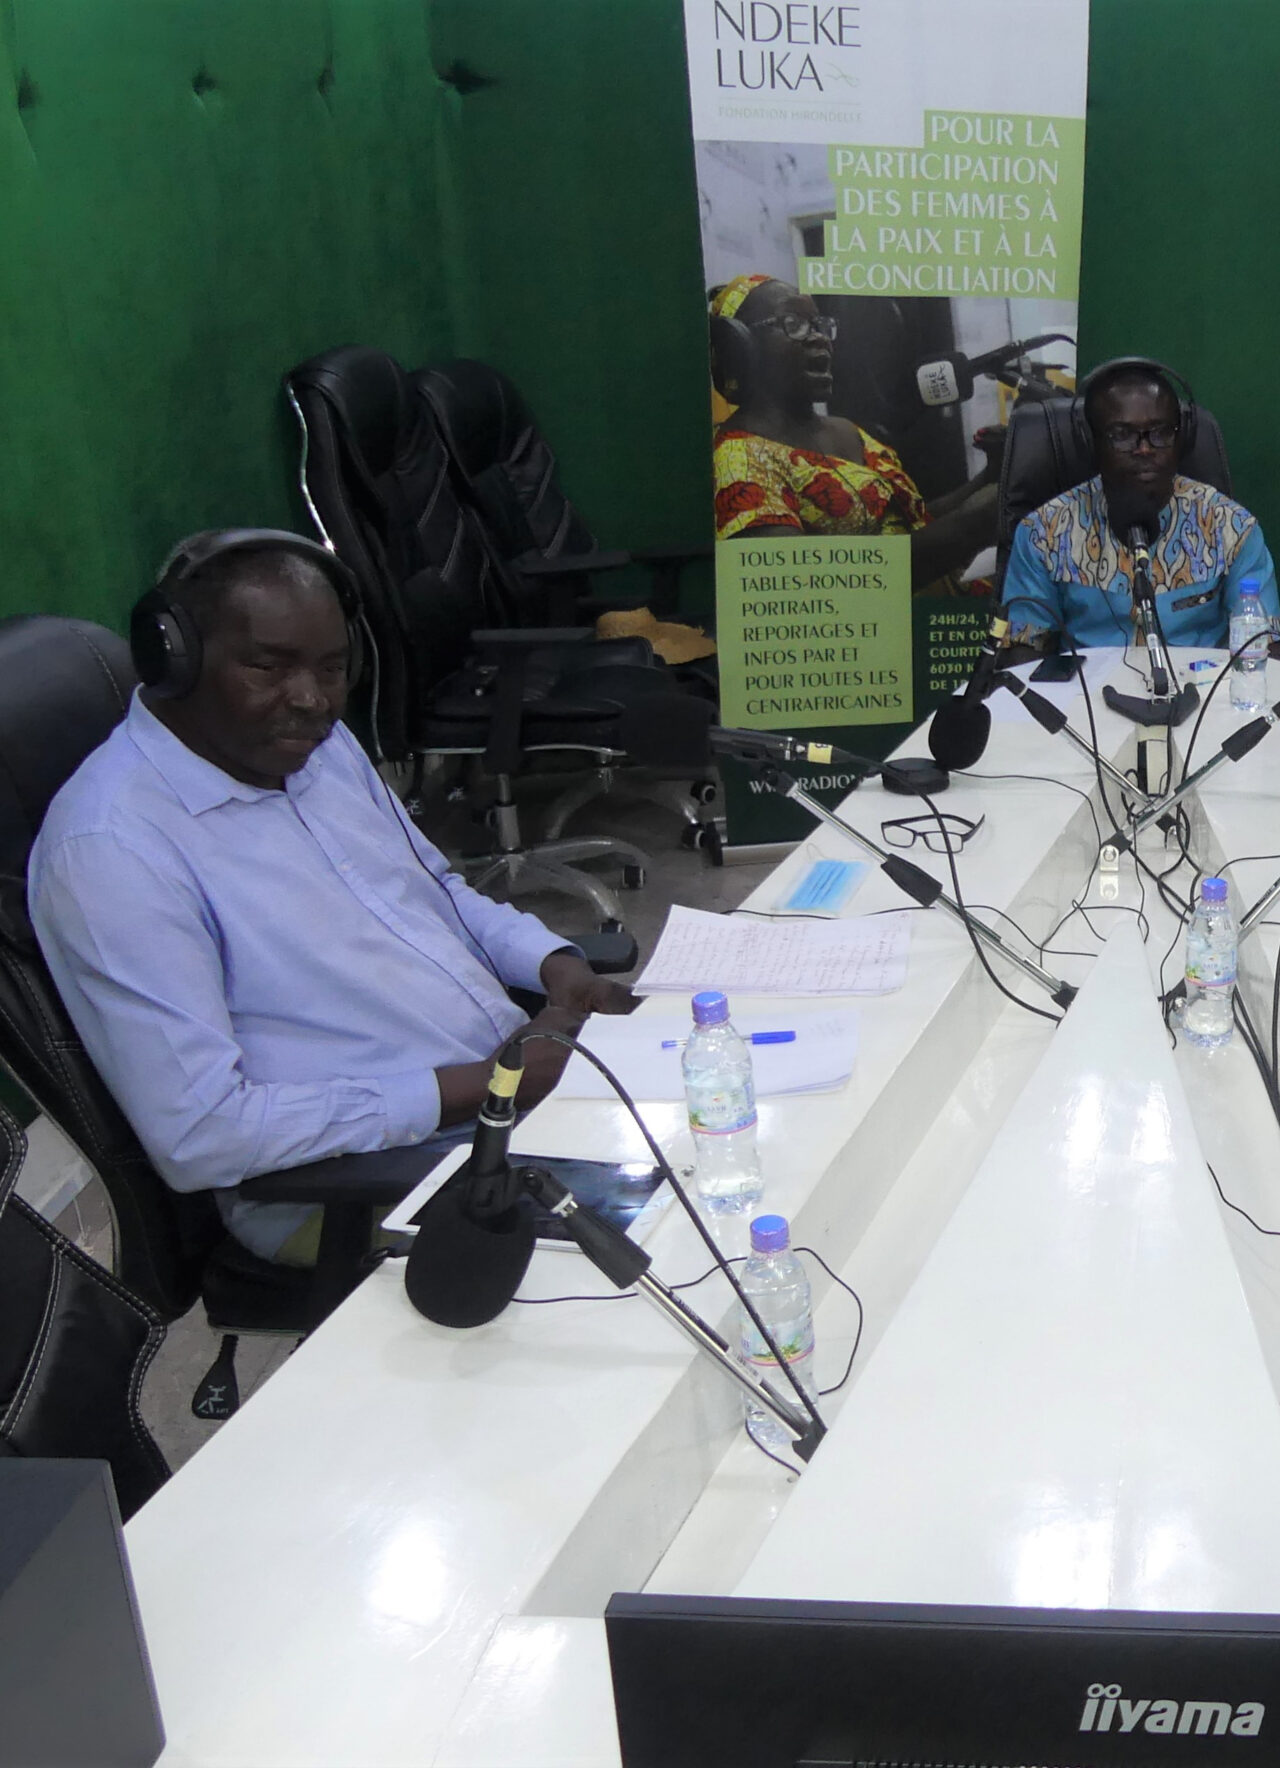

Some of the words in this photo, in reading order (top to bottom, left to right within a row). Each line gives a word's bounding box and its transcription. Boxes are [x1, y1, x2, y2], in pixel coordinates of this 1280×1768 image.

[714, 0, 862, 47] NDEKE
[716, 48, 824, 92] LUKA
[931, 116, 1013, 146] POUR
[1026, 120, 1060, 148] LA
[835, 149, 1058, 186] PARTICIPATION
[843, 188, 901, 217] DES
[912, 190, 1031, 220] FEMMES
[1040, 190, 1058, 222] À
[832, 226, 866, 253] LA
[878, 228, 943, 255] PAIX
[954, 229, 984, 256] ET
[995, 225, 1012, 256] À
[1024, 231, 1057, 259] LA
[806, 257, 1056, 294] RÉCONCILIATION
[739, 551, 786, 567] TOUS
[793, 549, 823, 566] LES
[829, 548, 889, 566] JOURS,
[740, 574, 888, 592] TABLES-RONDES,
[742, 599, 839, 617] PORTRAITS,
[743, 623, 855, 642] REPORTAGES
[861, 622, 878, 638] ET
[929, 631, 944, 642] ET
[949, 631, 965, 641] EN
[969, 630, 987, 641] ON
[744, 649, 797, 667] INFOS
[803, 648, 835, 664] PAR
[842, 647, 859, 662] ET
[745, 674, 794, 691] POUR
[801, 670, 863, 688] TOUTES
[870, 669, 898, 686] LES
[930, 679, 948, 691] DE
[746, 693, 903, 715] CENTRAFRICAINES
[1079, 1683, 1265, 1736] iiyama
